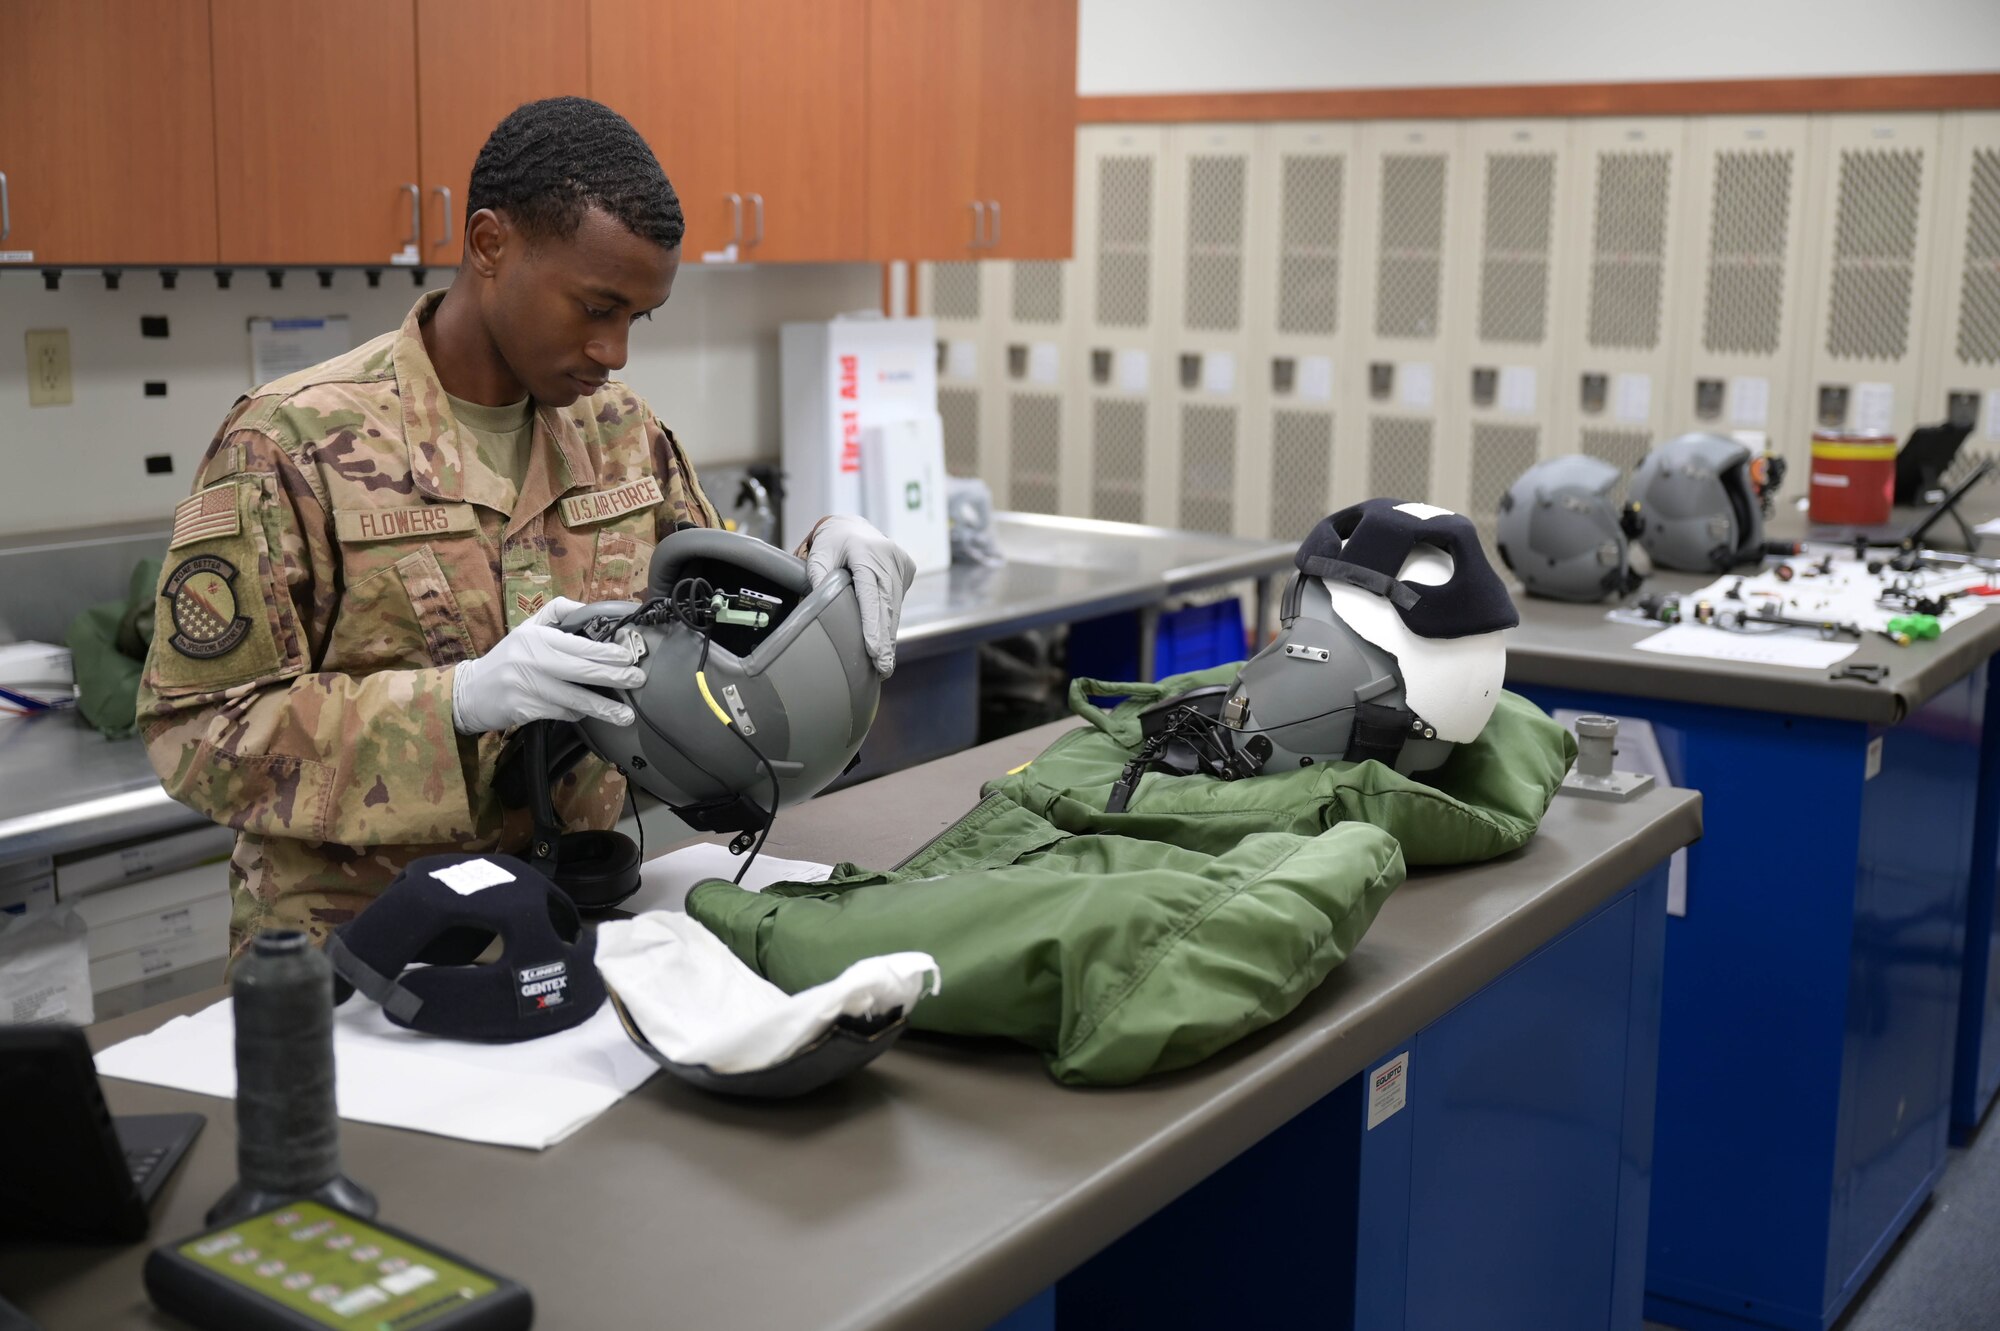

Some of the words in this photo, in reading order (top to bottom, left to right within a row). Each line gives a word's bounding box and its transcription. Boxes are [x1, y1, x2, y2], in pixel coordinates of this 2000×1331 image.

[839, 354, 859, 400] Aid
[840, 412, 861, 473] First
[593, 495, 613, 517] AIR
[608, 480, 659, 513] FORCE
[360, 507, 449, 538] FLOWERS
[174, 566, 192, 584] NONE
[193, 560, 221, 570] BETTER
[521, 975, 568, 997] GENTEX
[1376, 1065, 1402, 1088] EQUIPTO
